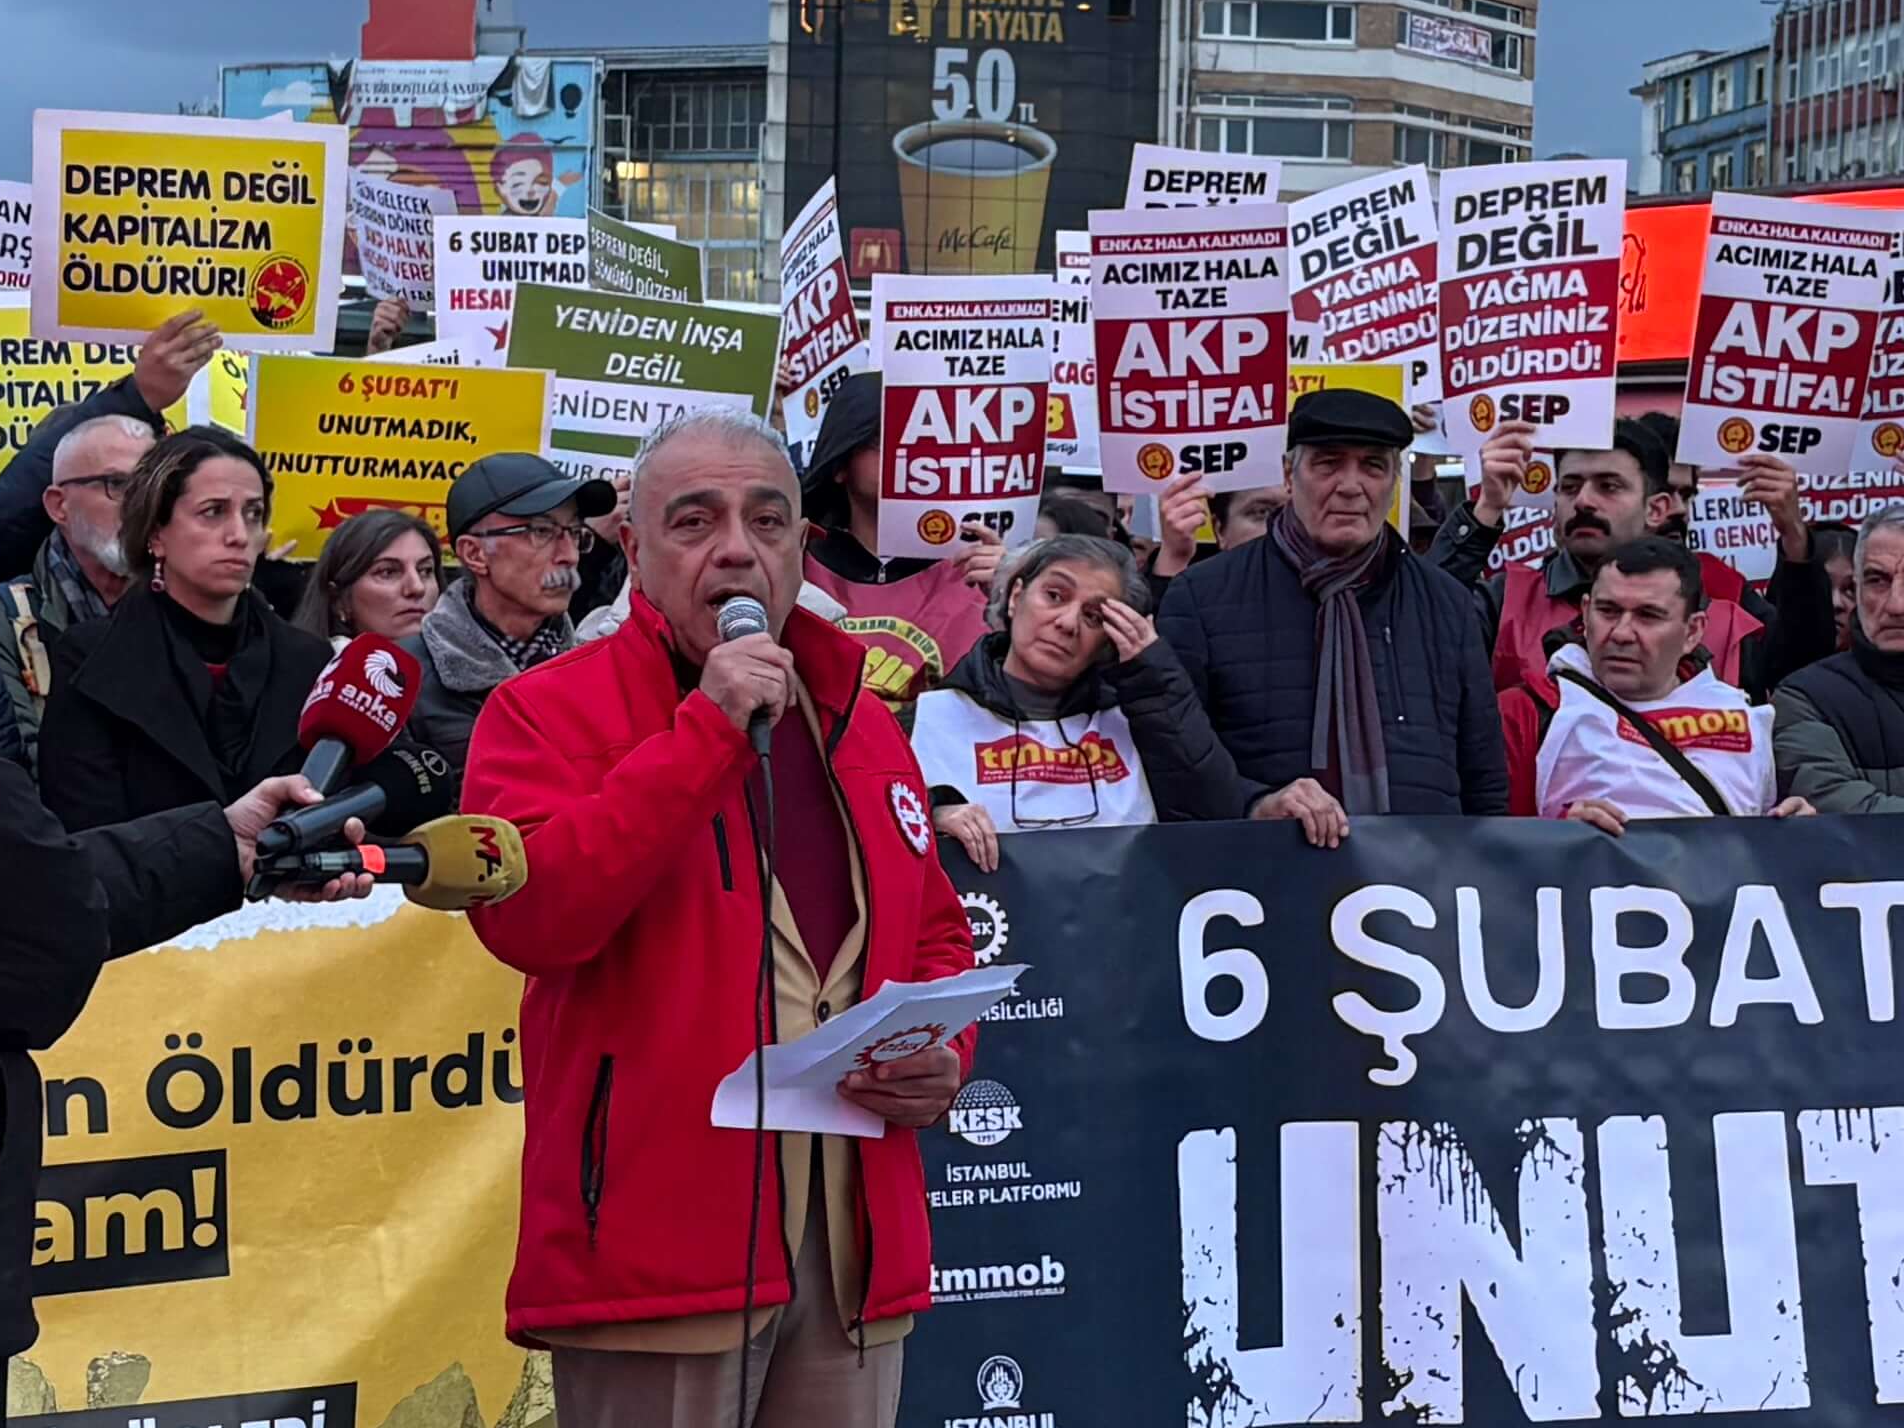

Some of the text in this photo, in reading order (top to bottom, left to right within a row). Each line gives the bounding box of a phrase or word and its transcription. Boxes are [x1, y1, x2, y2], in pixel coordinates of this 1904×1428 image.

[931, 47, 1038, 123] 50 TL
[64, 160, 317, 207] DEPREM DEĞİL
[1143, 169, 1267, 196] DEPREM
[1454, 175, 1607, 226] DEPREM
[64, 201, 272, 252] KAPİTALİZM
[1291, 179, 1416, 248] DEPREM
[1717, 219, 1886, 250] ENKAZ HALA KALKMADI
[450, 231, 539, 256] 6 ŞUBAT
[1100, 231, 1281, 253] ENKAZ HALA KALKMADI
[1300, 212, 1419, 282] DEĞİL
[1456, 212, 1599, 273] DEĞİL
[1716, 244, 1878, 278] ACIMIZ HALA
[63, 253, 246, 300] ÖLDÜRÜR!
[482, 260, 586, 283] UNUTMAD
[1103, 256, 1280, 285] ACIMIZ HALA
[1313, 256, 1420, 310] YAĞMA
[1463, 268, 1588, 312] YAĞMA
[1763, 274, 1829, 299] TAZE
[784, 267, 839, 349] AKP
[1156, 285, 1228, 311] TAZE
[1322, 283, 1438, 339] ÜZENİNİZ
[554, 303, 743, 354] YENİDEN İNŞA
[789, 312, 856, 383] STİFA!
[895, 327, 1044, 354] ACIMIZ HALA
[1113, 318, 1269, 378] AKP
[1444, 303, 1609, 353] DÜZENİNİZ
[1710, 301, 1859, 363] AKP
[606, 348, 685, 385] DEĞİL
[944, 355, 1006, 378] TAZE
[1449, 341, 1603, 389] ÖLDÜRDÜ!
[1699, 360, 1855, 413] İSTİFA!
[338, 373, 459, 404] 6 ŞUBAT'I
[1109, 377, 1275, 429] İSTİFA!
[1498, 394, 1570, 425] SEP
[318, 414, 478, 445] UNUTMADIK,
[899, 388, 1035, 445] AKP
[1758, 424, 1822, 454] SEP
[894, 447, 1036, 497] İSTİFA!
[1179, 442, 1248, 475] SEP
[340, 683, 398, 727] anka
[1178, 888, 1270, 1043] 6
[948, 1106, 1024, 1133] KESK
[946, 1162, 1032, 1183] İSTANBUL
[979, 1180, 1081, 1205] PLATFORMU
